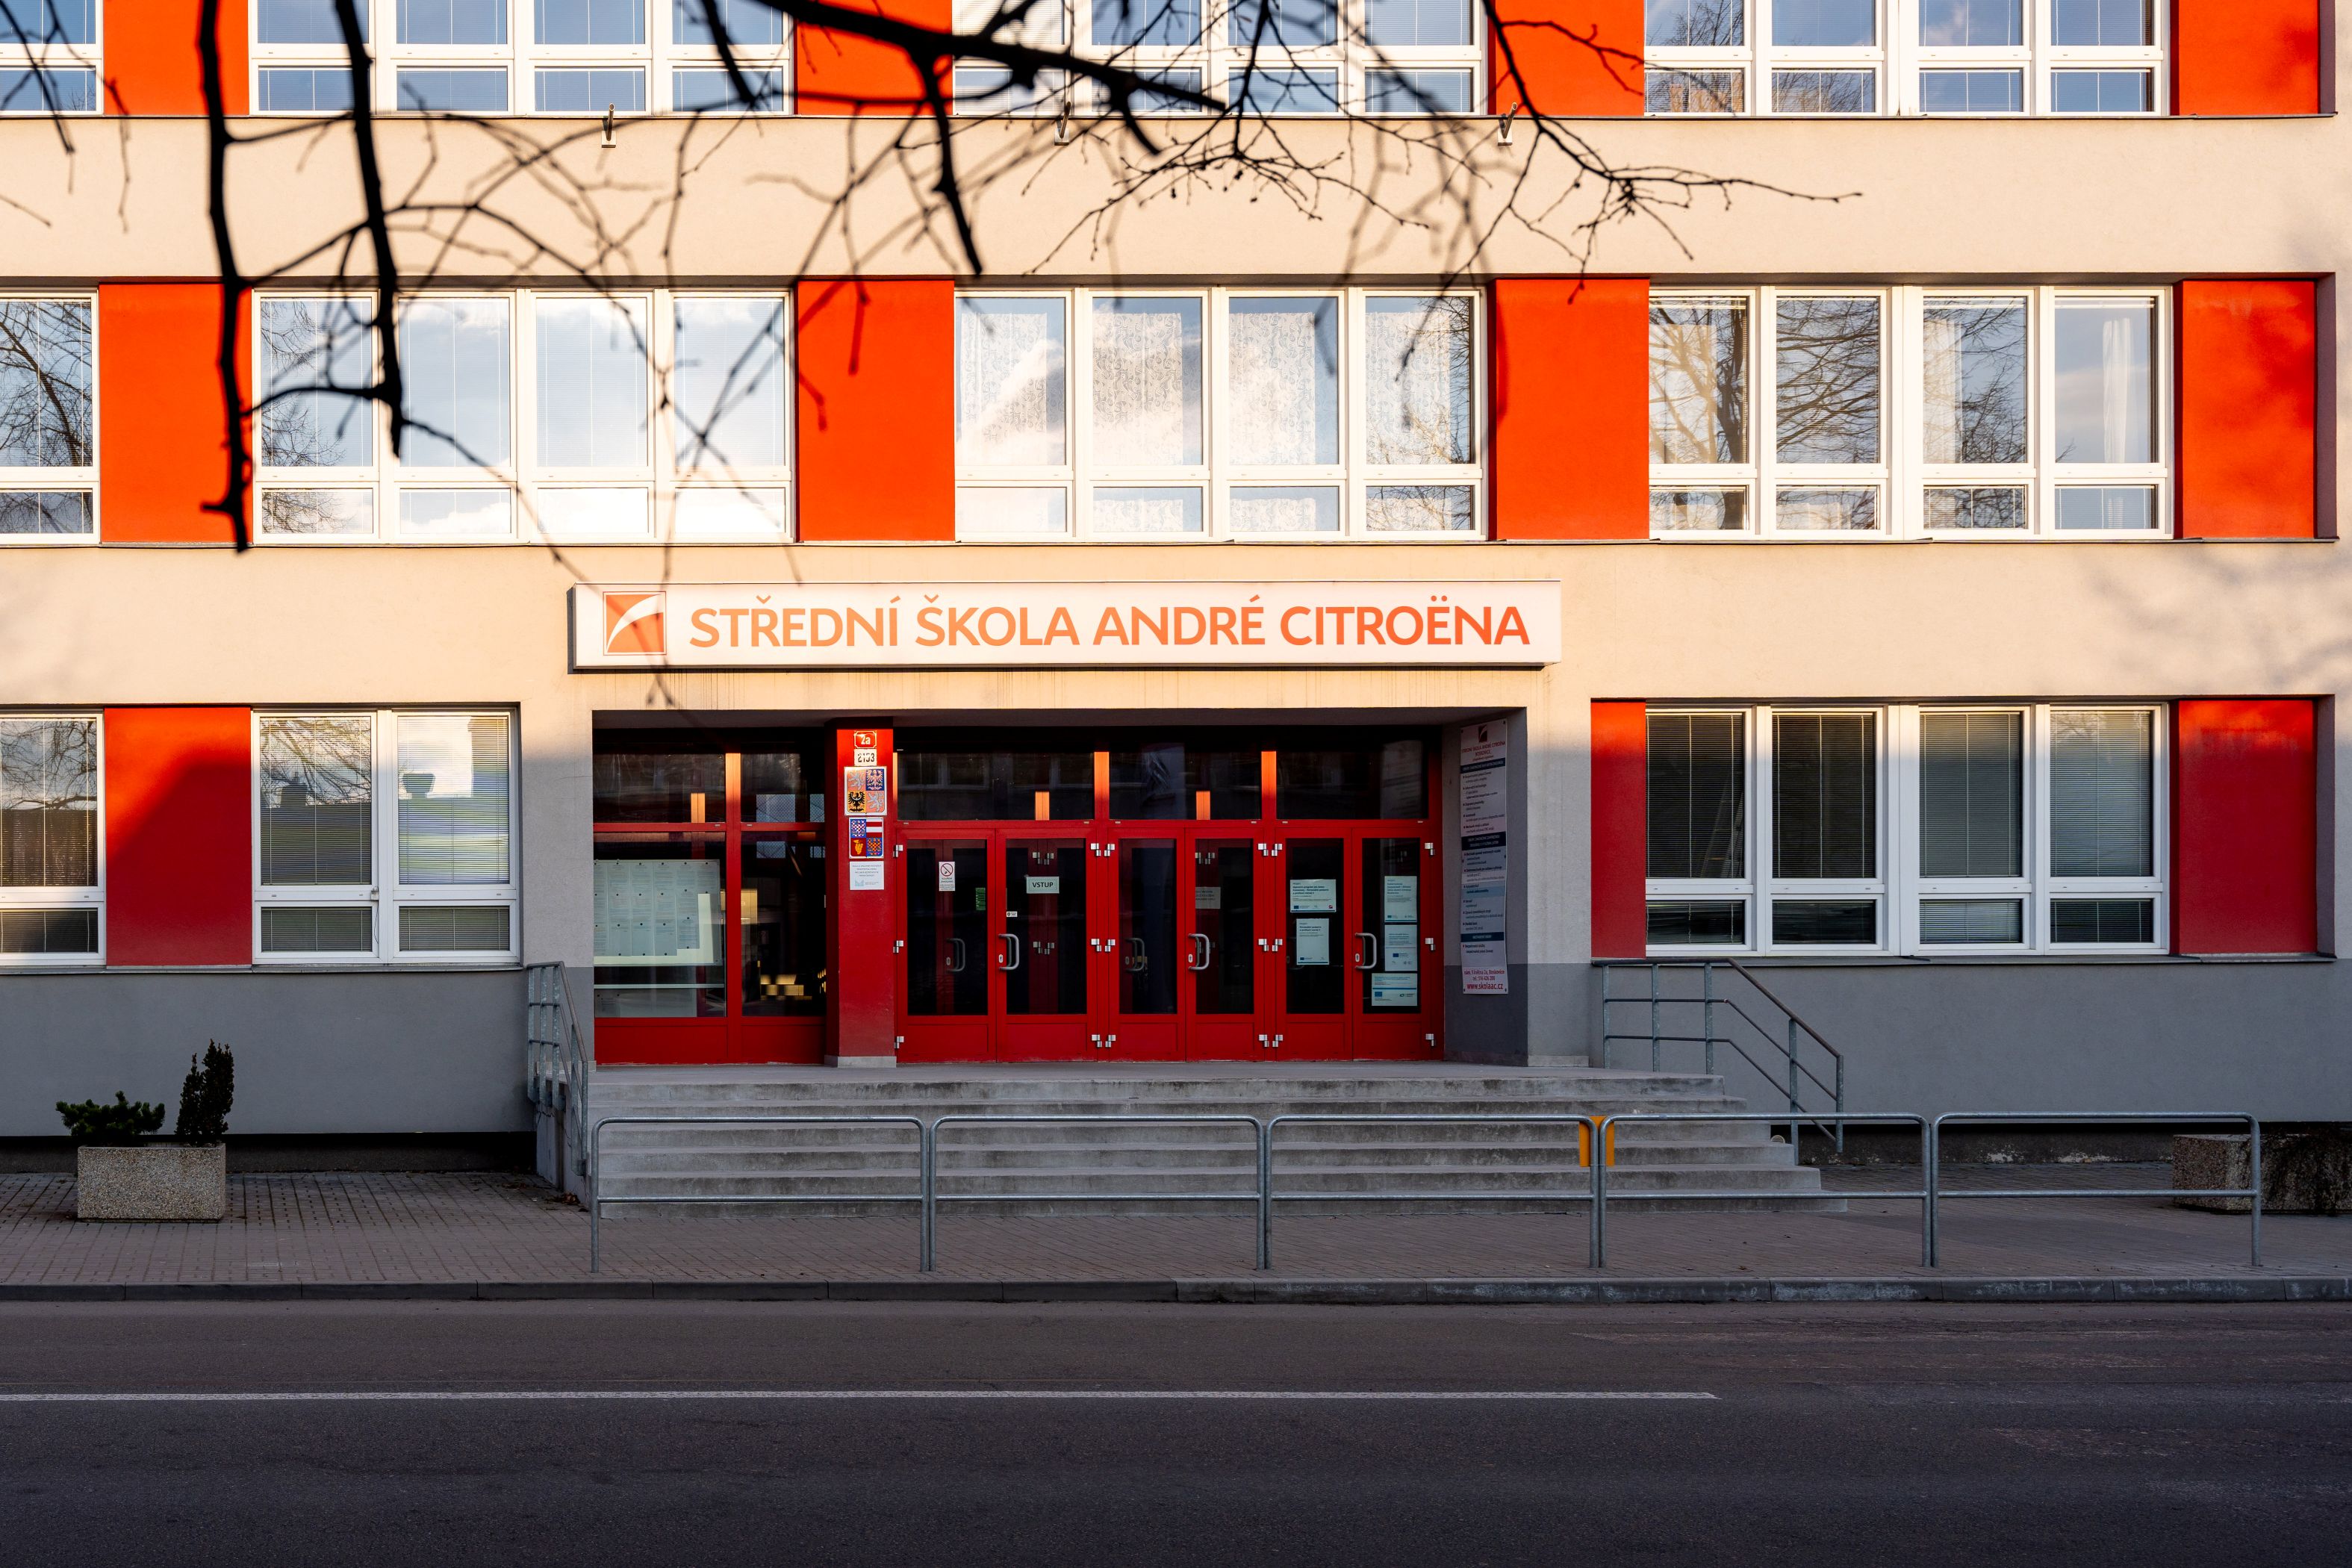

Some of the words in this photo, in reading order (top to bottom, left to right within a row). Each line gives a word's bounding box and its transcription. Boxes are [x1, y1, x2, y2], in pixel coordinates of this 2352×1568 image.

[690, 597, 901, 647] STŘEDNÍ
[915, 594, 1080, 647] ŠKOLA
[1093, 595, 1266, 645] ANDRÉ
[1280, 595, 1531, 645] CITROËNA
[861, 733, 871, 745] 2a
